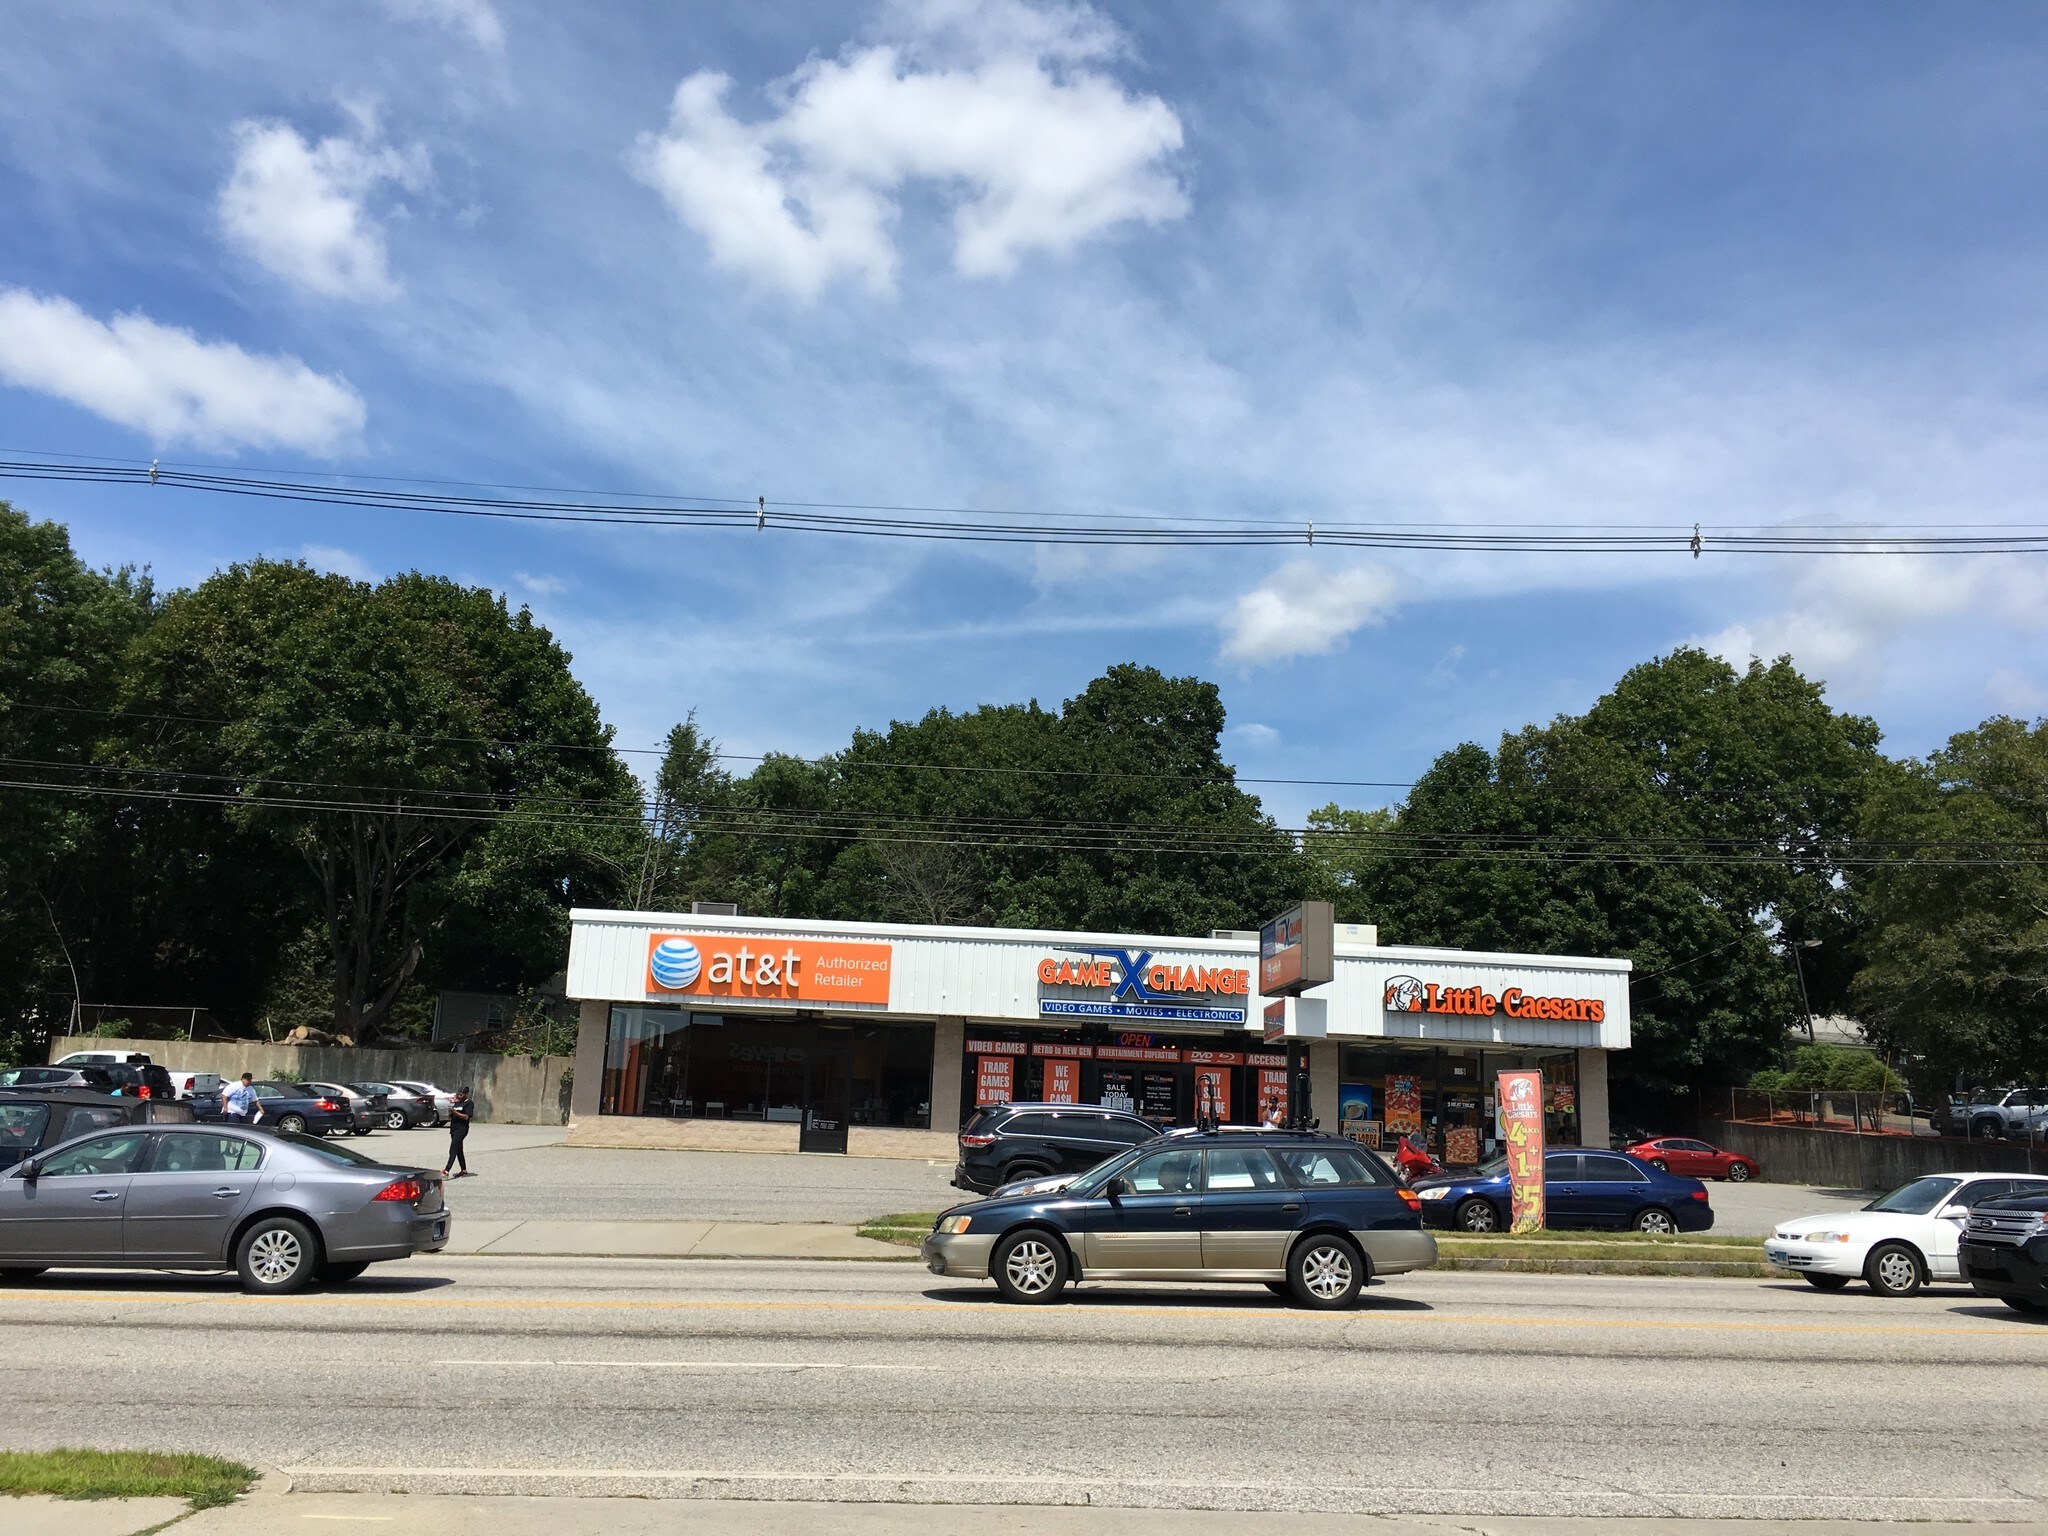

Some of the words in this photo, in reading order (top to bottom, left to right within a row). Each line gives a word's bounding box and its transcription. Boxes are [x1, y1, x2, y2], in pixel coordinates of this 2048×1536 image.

[708, 946, 801, 987] at&t
[816, 955, 888, 972] Authorized
[814, 973, 864, 987] Retailer
[1424, 983, 1496, 1016] Little
[1502, 987, 1605, 1022] Caesars
[1044, 1002, 1075, 1013] VIDEO
[1078, 1004, 1113, 1014] GAMES
[1125, 1006, 1164, 1017] MOVIES
[1176, 1009, 1241, 1021] ELECTRONICS
[968, 1040, 993, 1053] VIDEO
[995, 1042, 1026, 1054] GAMES
[1120, 1033, 1151, 1047] OPEN
[1033, 1045, 1053, 1055] RETRO
[1054, 1047, 1061, 1056] to
[1062, 1046, 1077, 1056] NEW
[1078, 1047, 1092, 1057] GEN
[1098, 1048, 1143, 1058] ENTERTAINMENT
[1144, 1050, 1178, 1060] SUPERSTORE
[1191, 1051, 1213, 1060] DVD
[983, 1061, 1009, 1074] TRADE
[1055, 1065, 1069, 1078] WE
[980, 1074, 1010, 1088] GAMES
[1053, 1079, 1070, 1092] PAY
[1106, 1083, 1126, 1091] SALE
[979, 1088, 986, 1101] &
[988, 1088, 1010, 1102] DVDs
[1203, 1086, 1222, 1099] SLL
[1200, 1101, 1226, 1114] TRDE
[1511, 1102, 1534, 1111] Little
[1506, 1110, 1538, 1119] Caesars
[1509, 1121, 1527, 1147] 4
[1515, 1151, 1531, 1178] 1
[1514, 1182, 1541, 1215] $5
